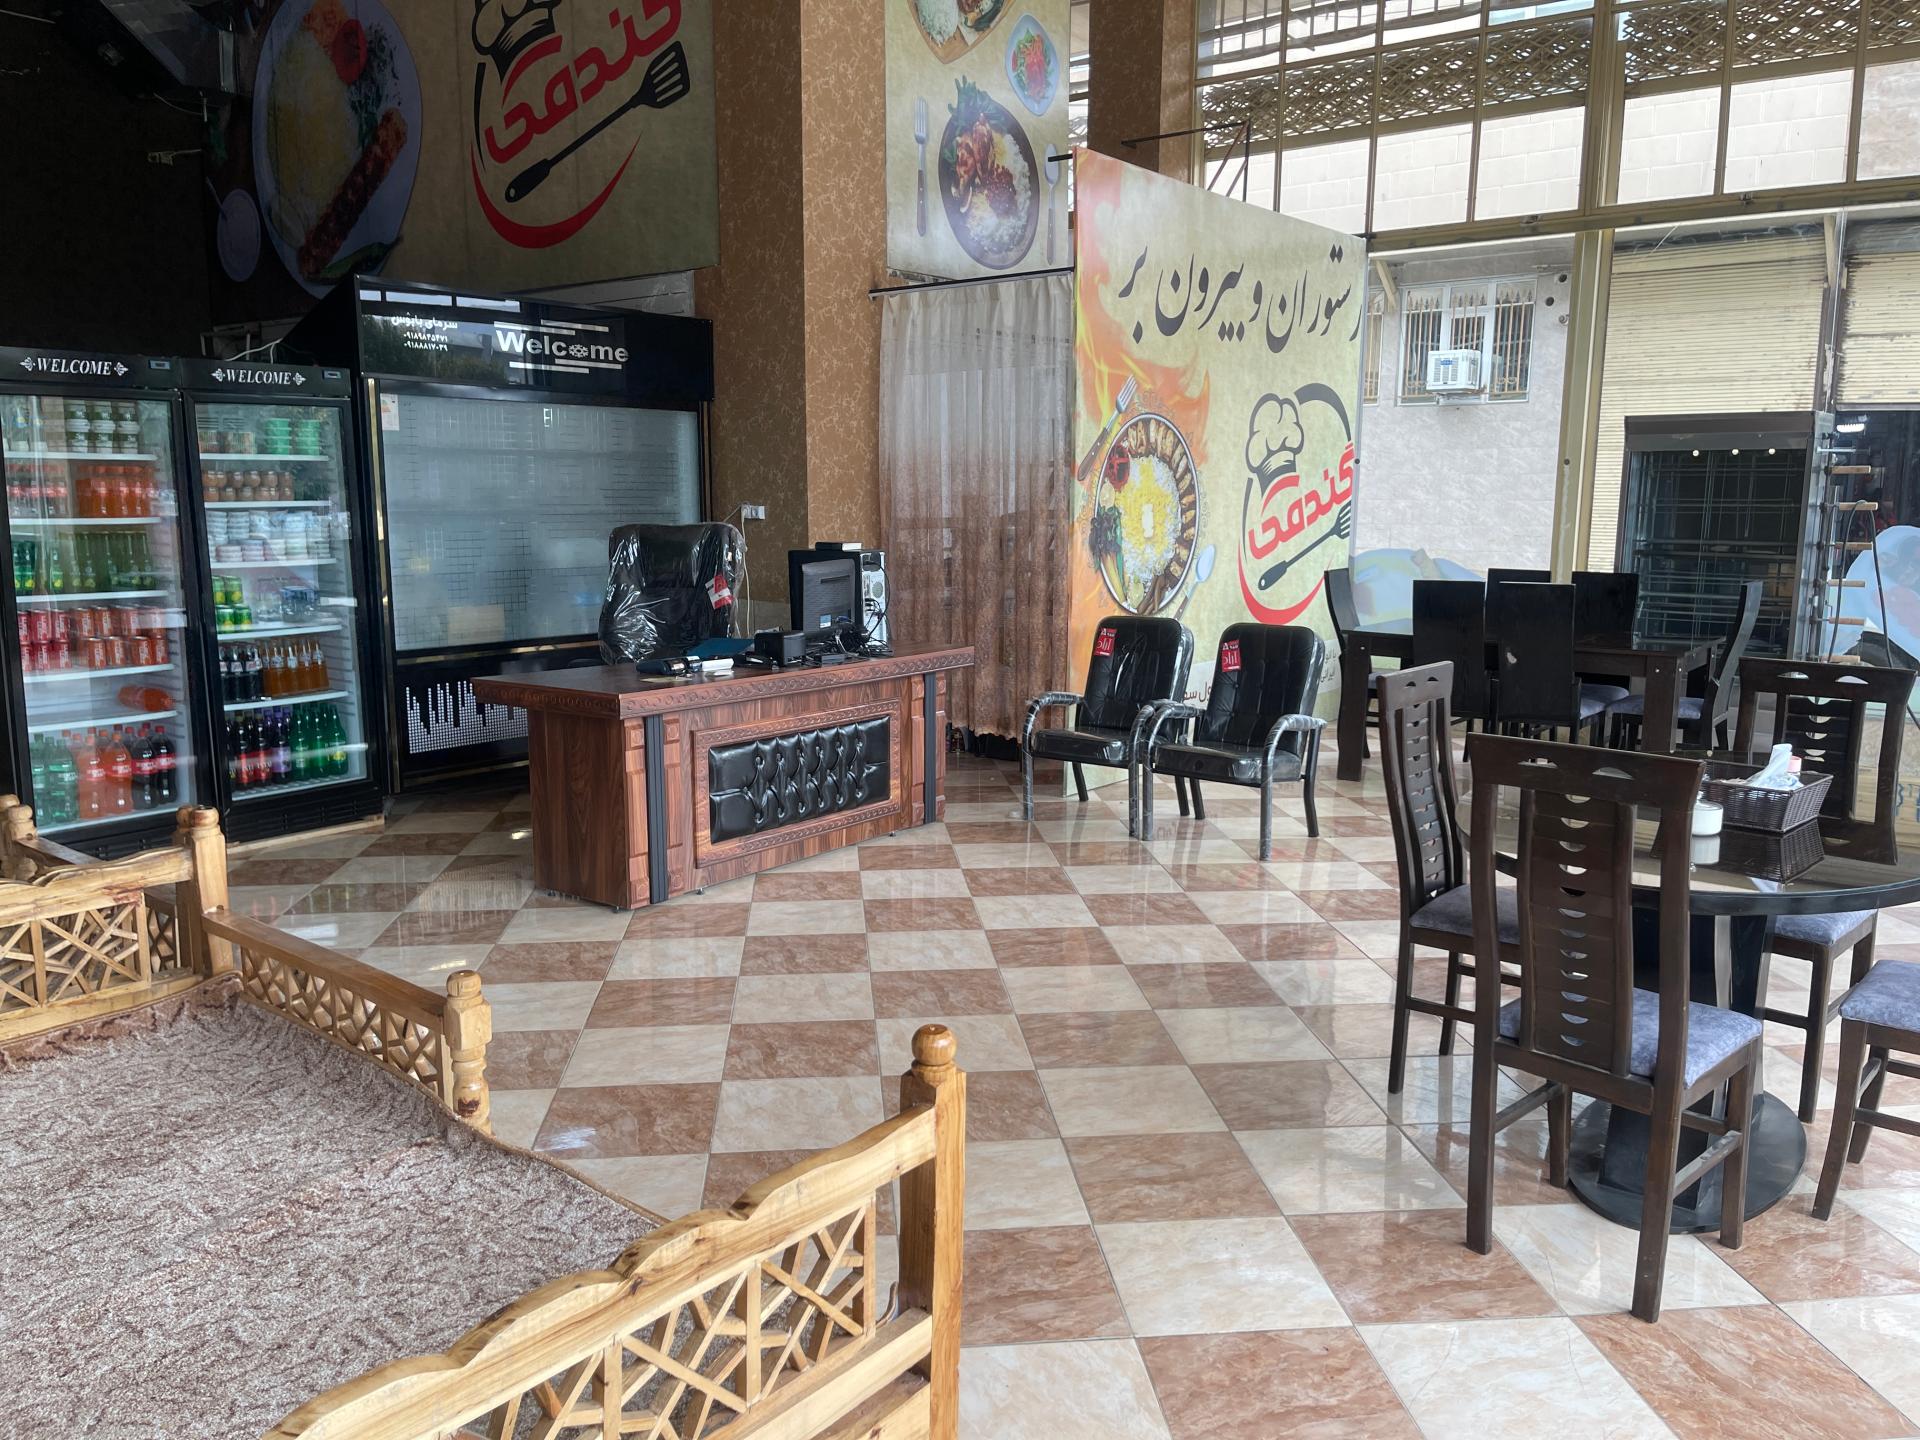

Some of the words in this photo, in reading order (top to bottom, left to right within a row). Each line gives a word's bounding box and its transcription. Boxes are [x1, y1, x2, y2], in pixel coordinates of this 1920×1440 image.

[1117, 245, 1149, 345] بر
[1154, 252, 1245, 342] بیرون
[1249, 279, 1263, 323] و
[1265, 243, 1363, 354] رستوران
[36, 357, 112, 376] WELCOME
[495, 329, 630, 362] Welcome
[225, 368, 292, 386] WELCOME
